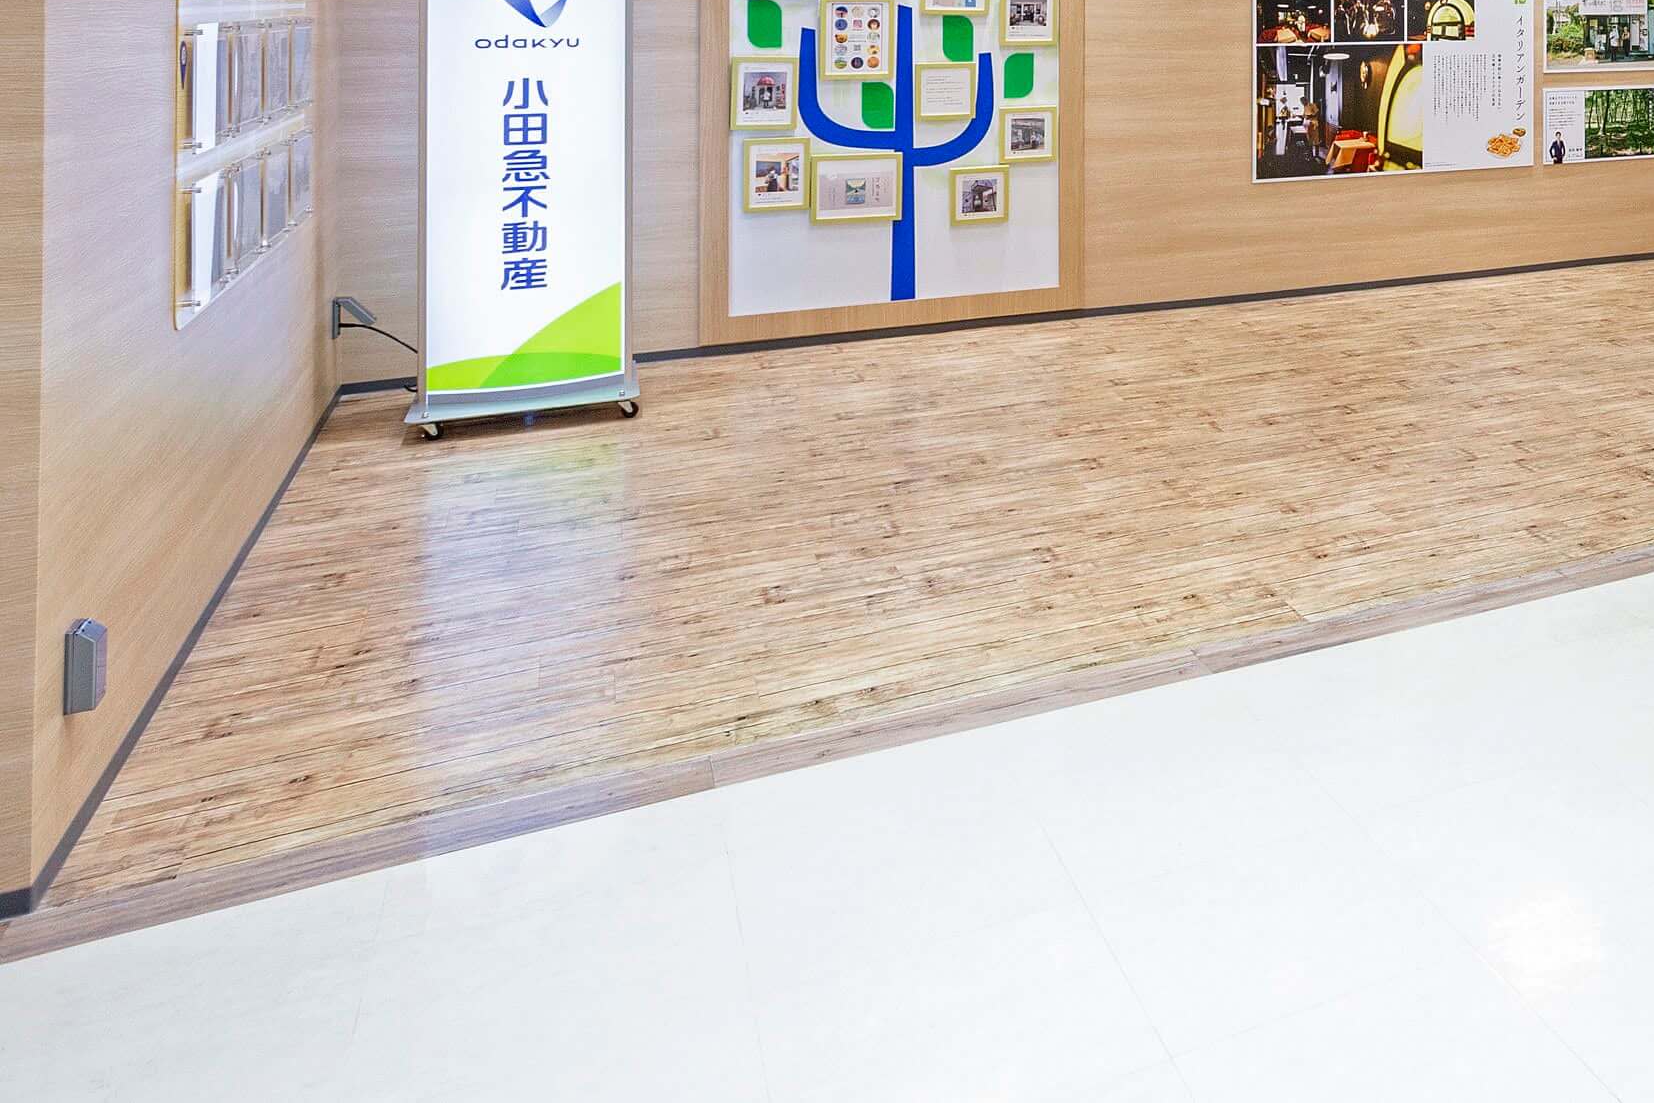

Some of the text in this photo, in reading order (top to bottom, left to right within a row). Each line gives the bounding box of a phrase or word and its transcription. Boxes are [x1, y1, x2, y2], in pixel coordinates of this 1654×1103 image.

[474, 34, 580, 49] odakyu
[1515, 15, 1527, 121] イタリアンガーデン
[501, 77, 550, 290] 小田急不動産
